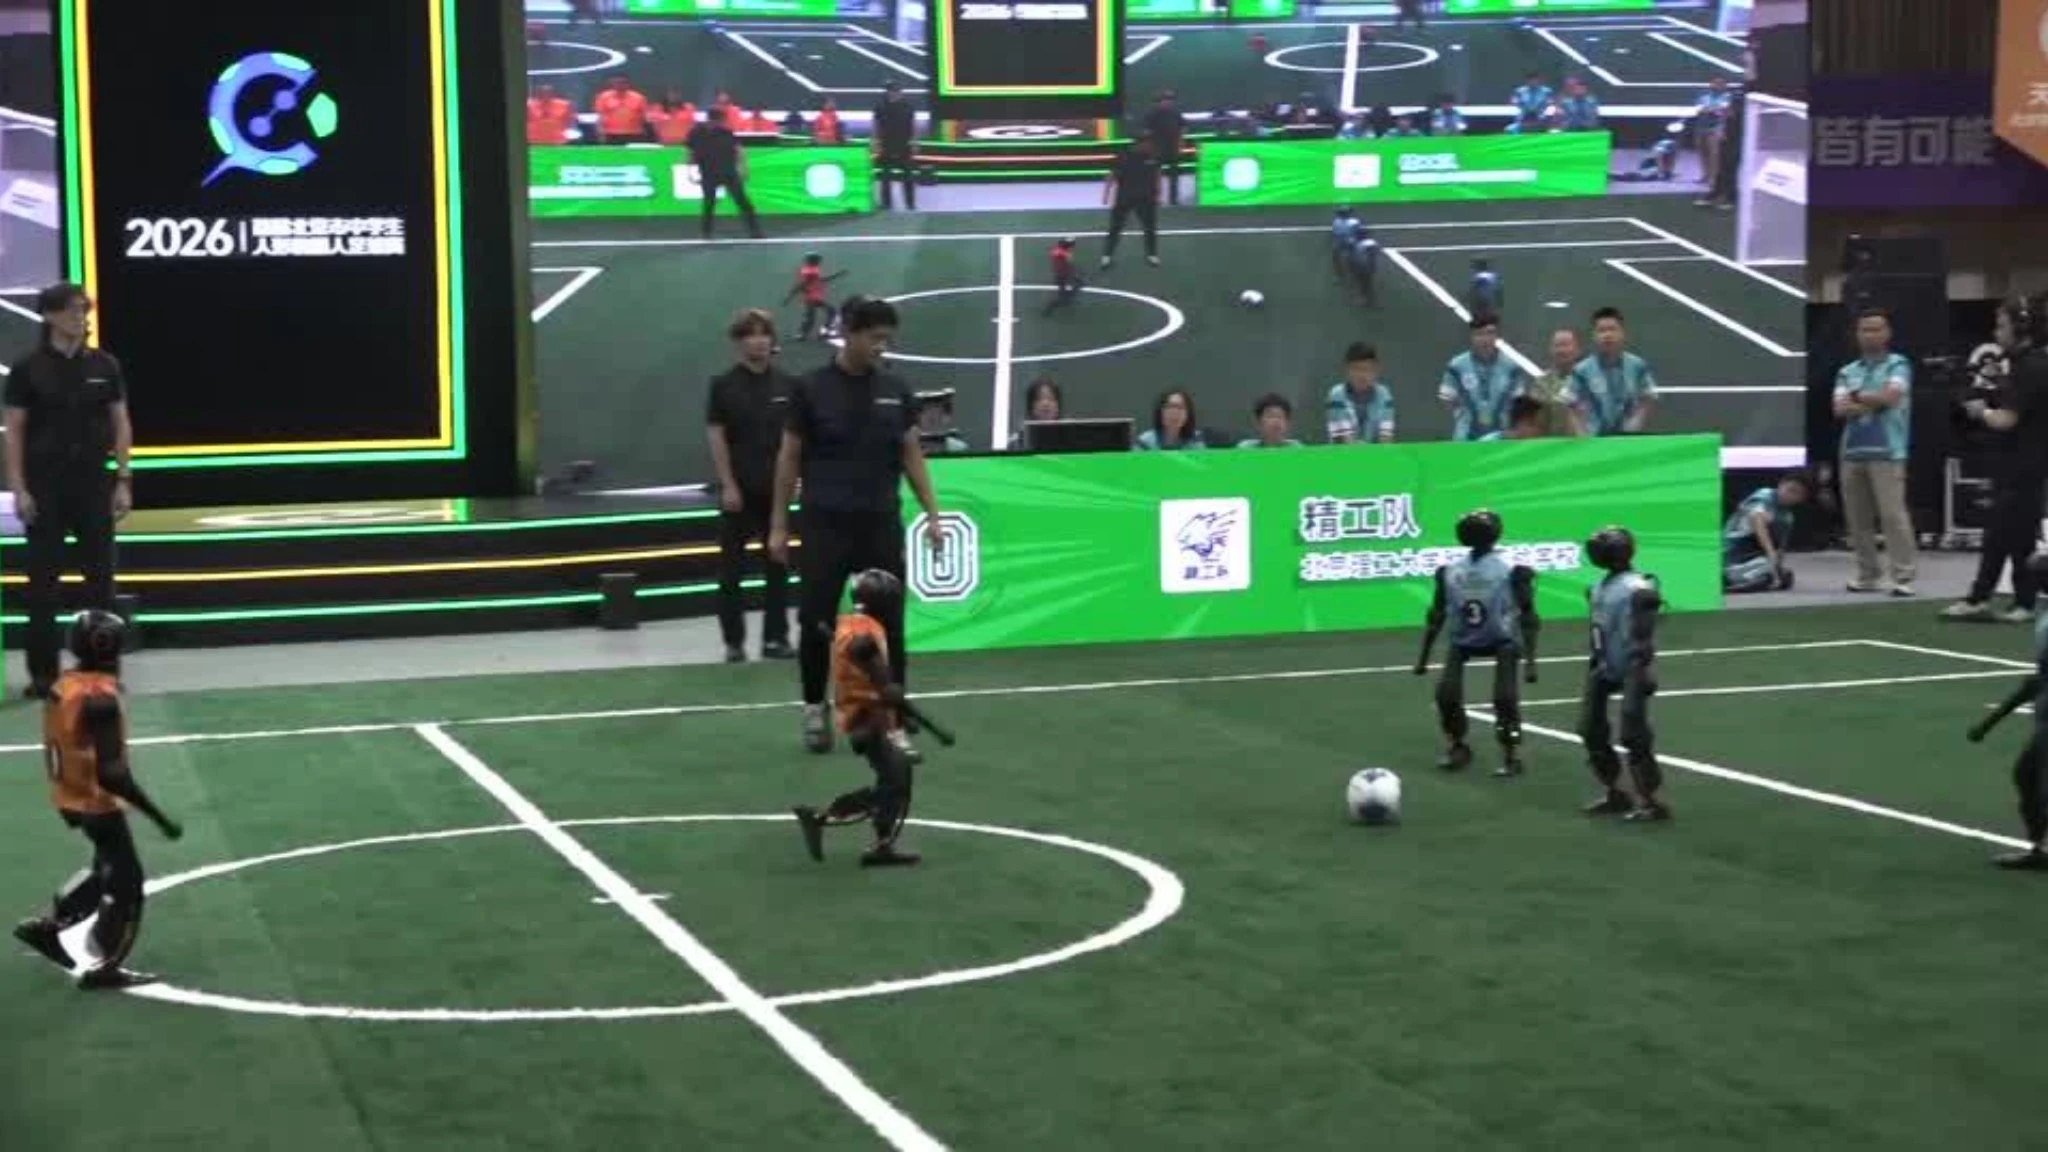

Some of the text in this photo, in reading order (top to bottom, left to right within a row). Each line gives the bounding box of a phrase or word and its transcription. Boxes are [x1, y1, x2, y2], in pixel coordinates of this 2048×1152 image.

[1815, 116, 1995, 166] 皆有可能
[125, 218, 234, 257] 2026
[1301, 494, 1420, 540] 精工队
[1467, 601, 1483, 625] 3
